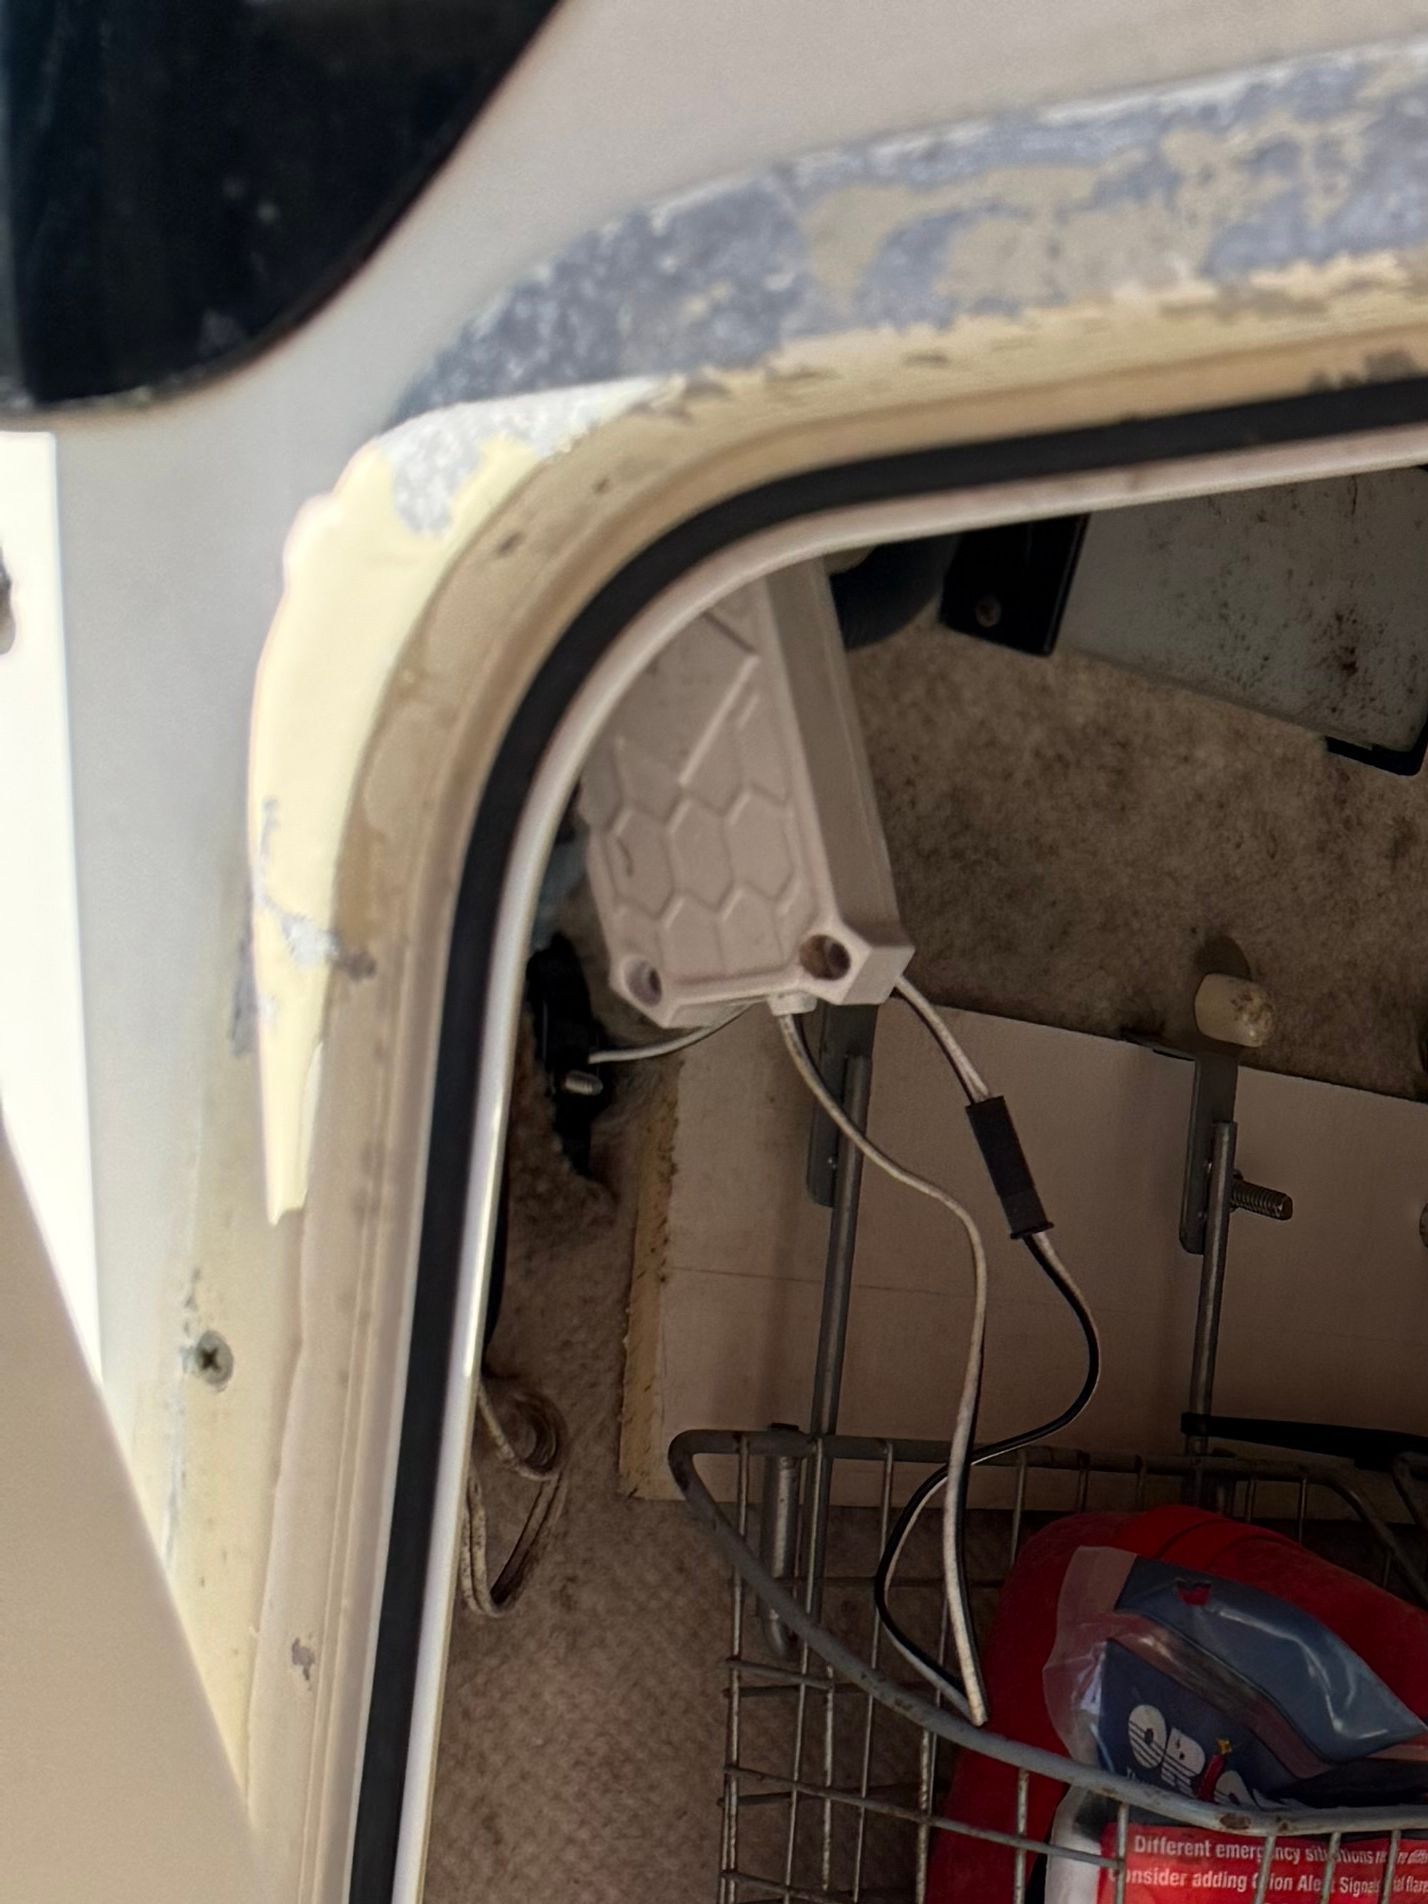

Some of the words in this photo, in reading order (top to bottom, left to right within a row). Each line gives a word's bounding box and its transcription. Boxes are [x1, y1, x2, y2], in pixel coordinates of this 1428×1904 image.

[1128, 1704, 1290, 1808] ORIO
[1134, 1835, 1212, 1858] Different
[1215, 1843, 1301, 1866] emergncy
[1305, 1846, 1374, 1865] sittions
[1108, 1867, 1186, 1887] Cnsider
[1192, 1871, 1247, 1893] adding
[1252, 1874, 1294, 1892] Oion
[1297, 1875, 1336, 1893] Alet
